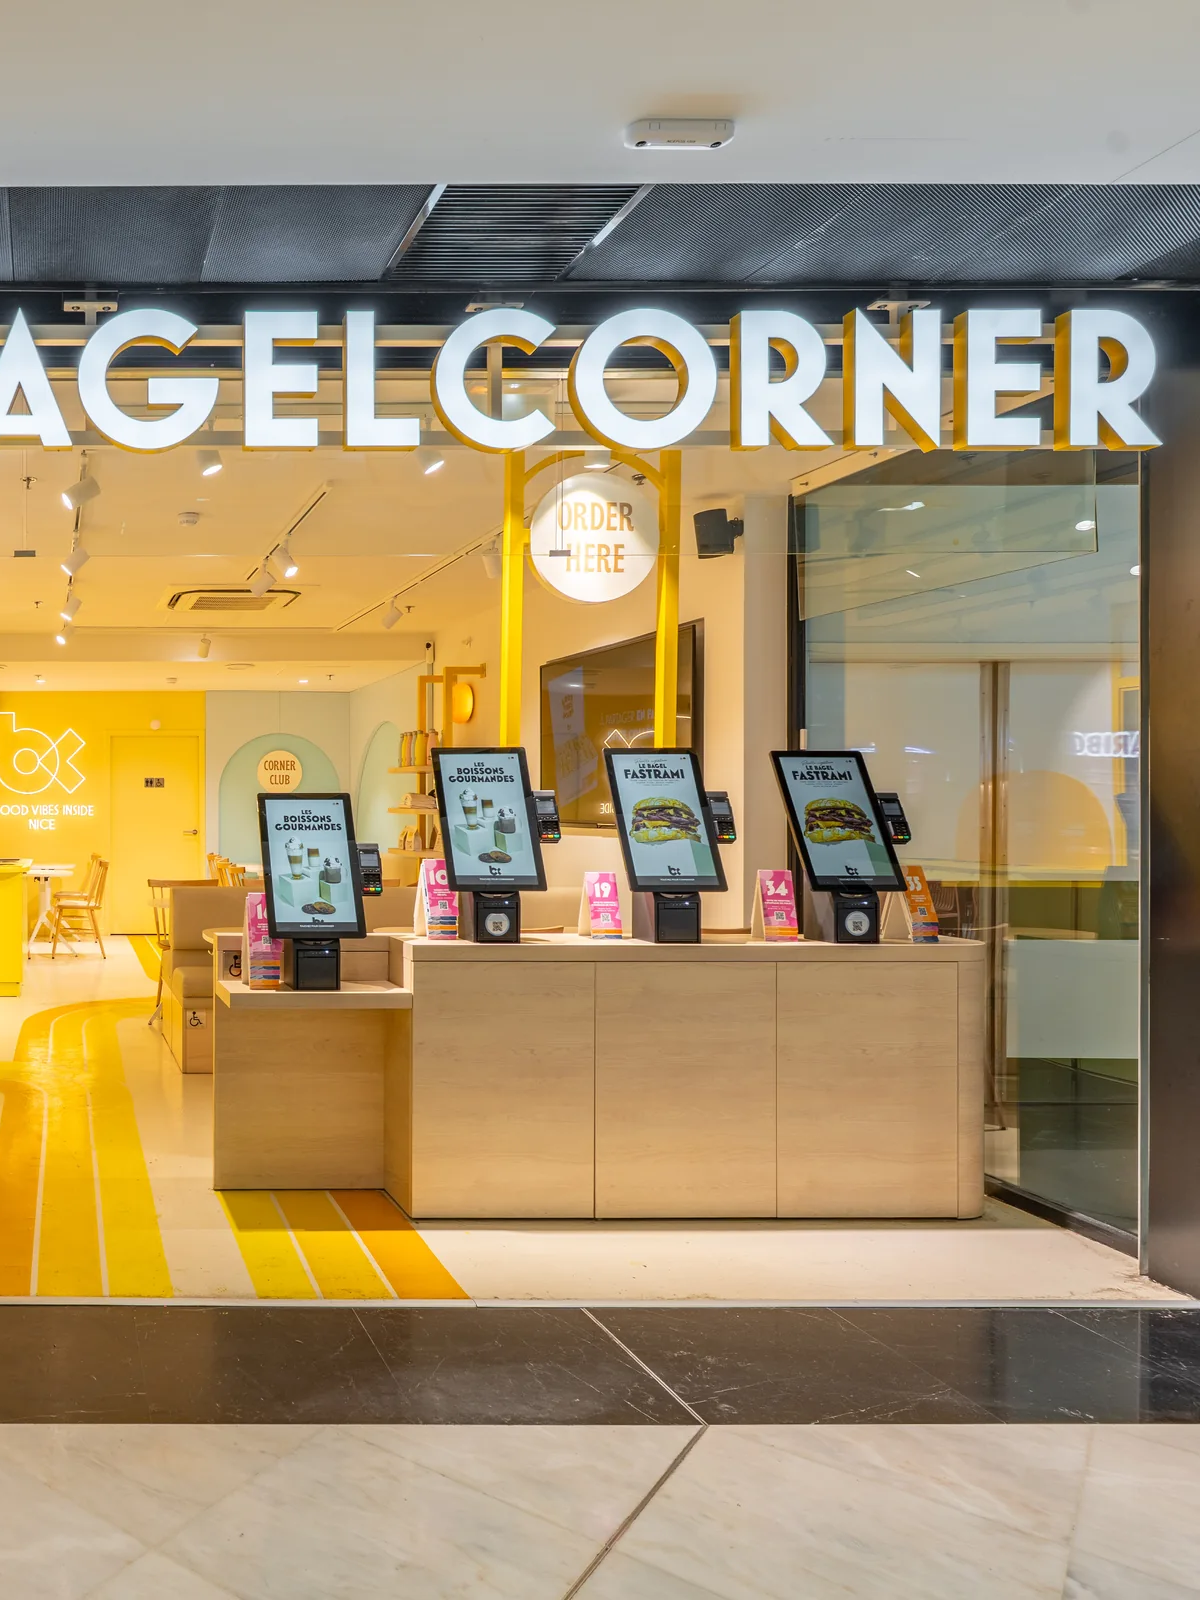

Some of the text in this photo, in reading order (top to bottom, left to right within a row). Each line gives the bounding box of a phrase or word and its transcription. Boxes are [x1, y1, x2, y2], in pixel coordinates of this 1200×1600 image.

[556, 501, 634, 533] ORDER
[565, 542, 625, 573] HERE
[263, 759, 296, 772] CORNER
[456, 767, 505, 775] BOISSONS
[448, 775, 515, 783] GOURMANDES
[623, 768, 685, 779] FASTRAMI
[791, 770, 853, 781] FASTRAMI
[269, 774, 291, 785] CLUB
[31, 804, 60, 816] VIBES
[62, 804, 94, 816] INSIDE
[28, 819, 56, 830] NICE
[283, 815, 332, 823] BOISSONS
[275, 822, 342, 831] GOURMANDES
[594, 882, 611, 898] 19
[765, 880, 789, 896] 34
